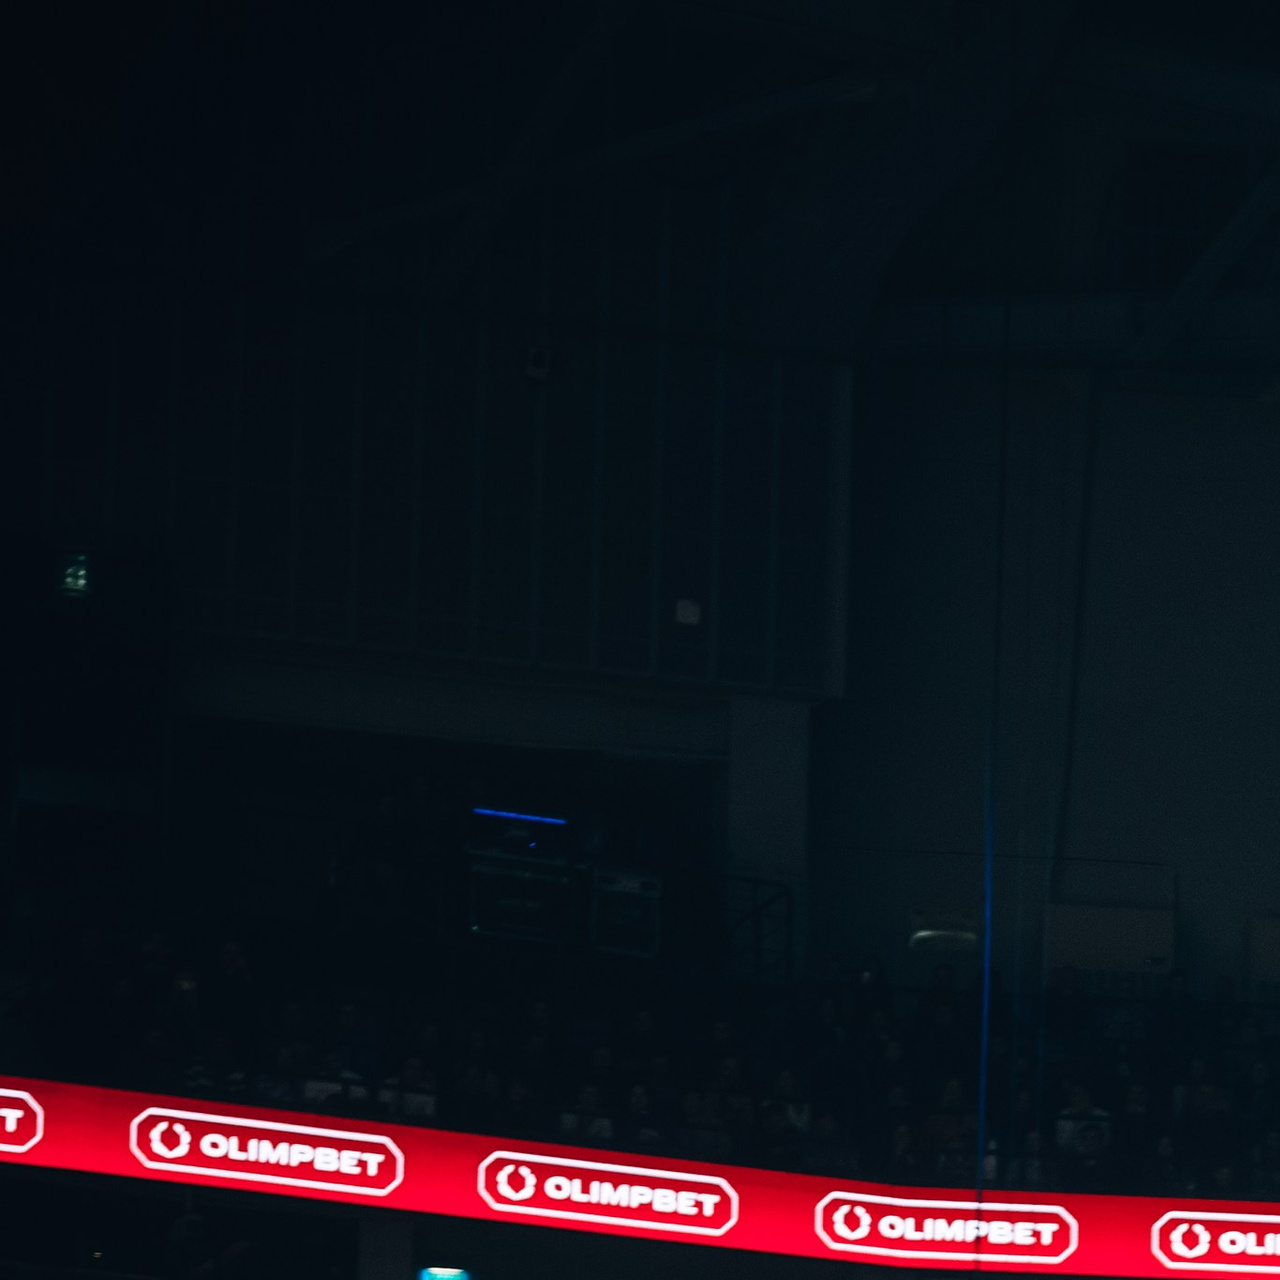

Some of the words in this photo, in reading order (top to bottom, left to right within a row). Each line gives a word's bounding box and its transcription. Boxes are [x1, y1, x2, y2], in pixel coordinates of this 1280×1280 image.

[199, 1133, 386, 1177] OLIMPBET
[543, 1175, 721, 1217] OLIMPBET
[877, 1215, 1060, 1246] OLIMPBET
